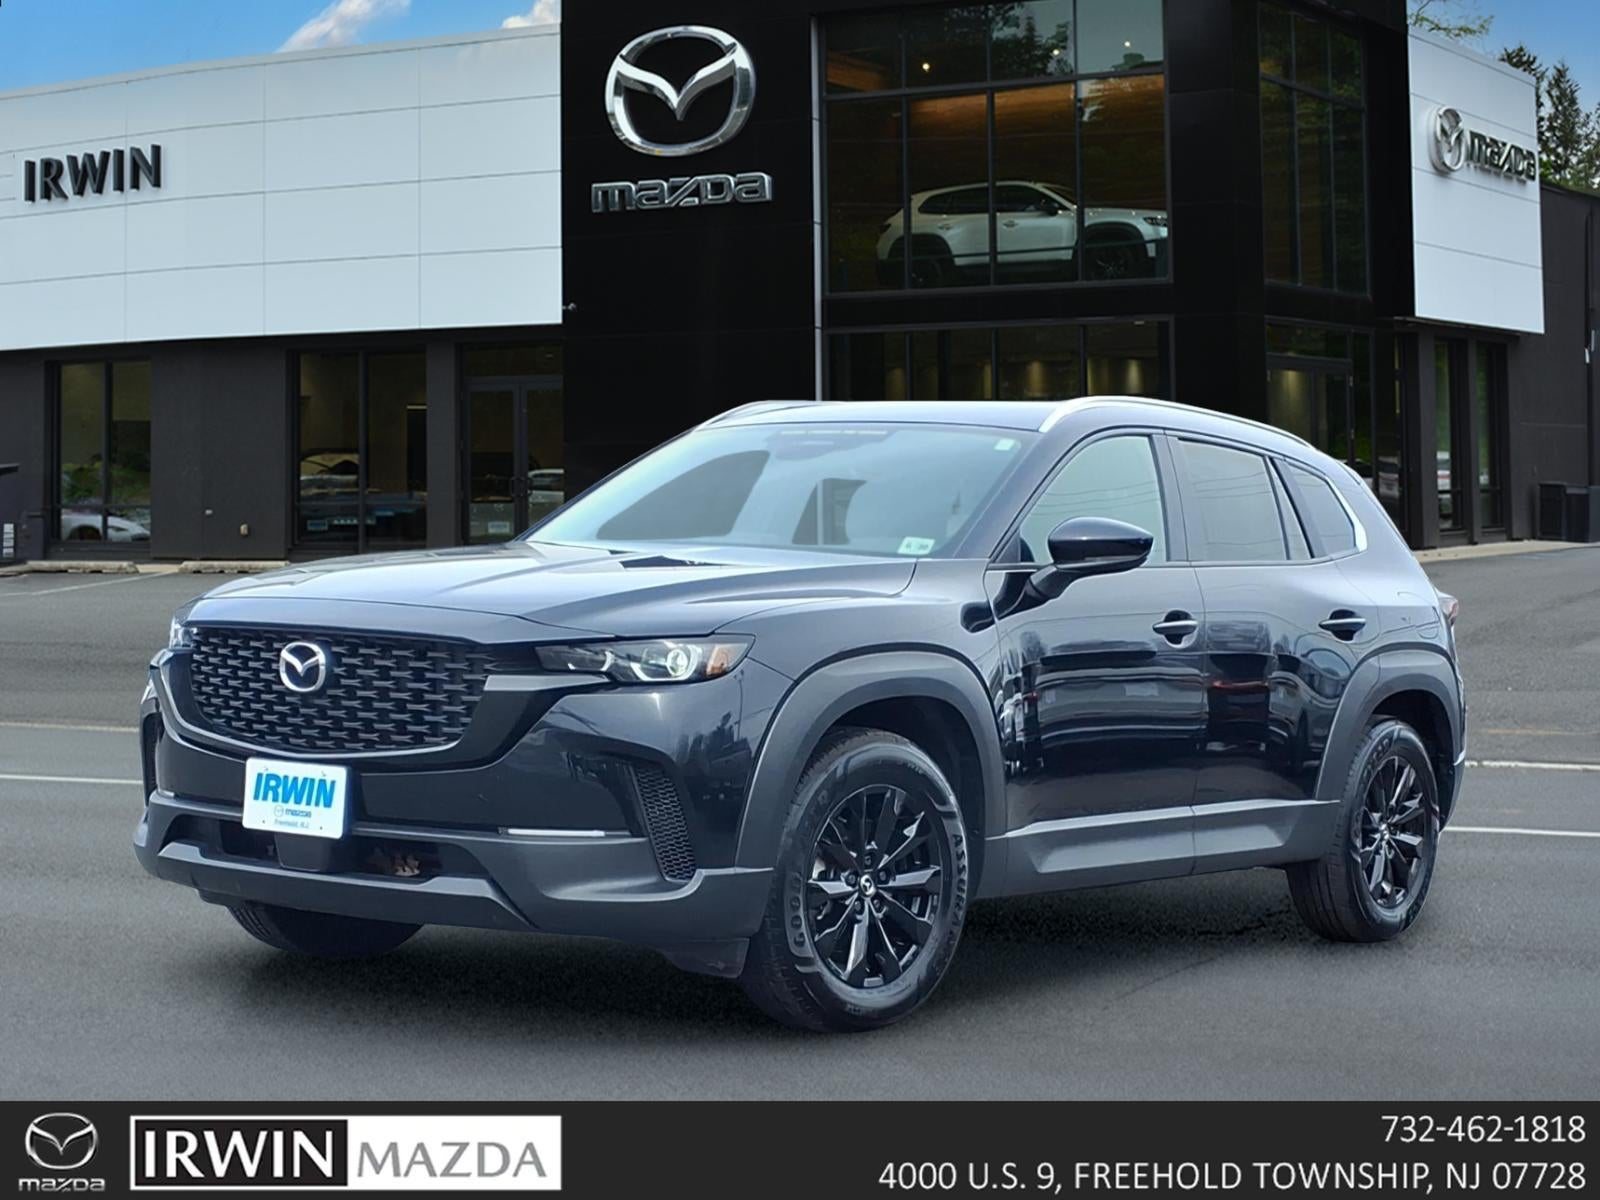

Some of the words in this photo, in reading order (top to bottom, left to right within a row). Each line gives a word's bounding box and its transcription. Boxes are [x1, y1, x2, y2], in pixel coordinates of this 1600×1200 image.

[24, 143, 161, 203] IRWIN
[591, 171, 772, 213] mazda
[253, 772, 336, 808] IRWIN
